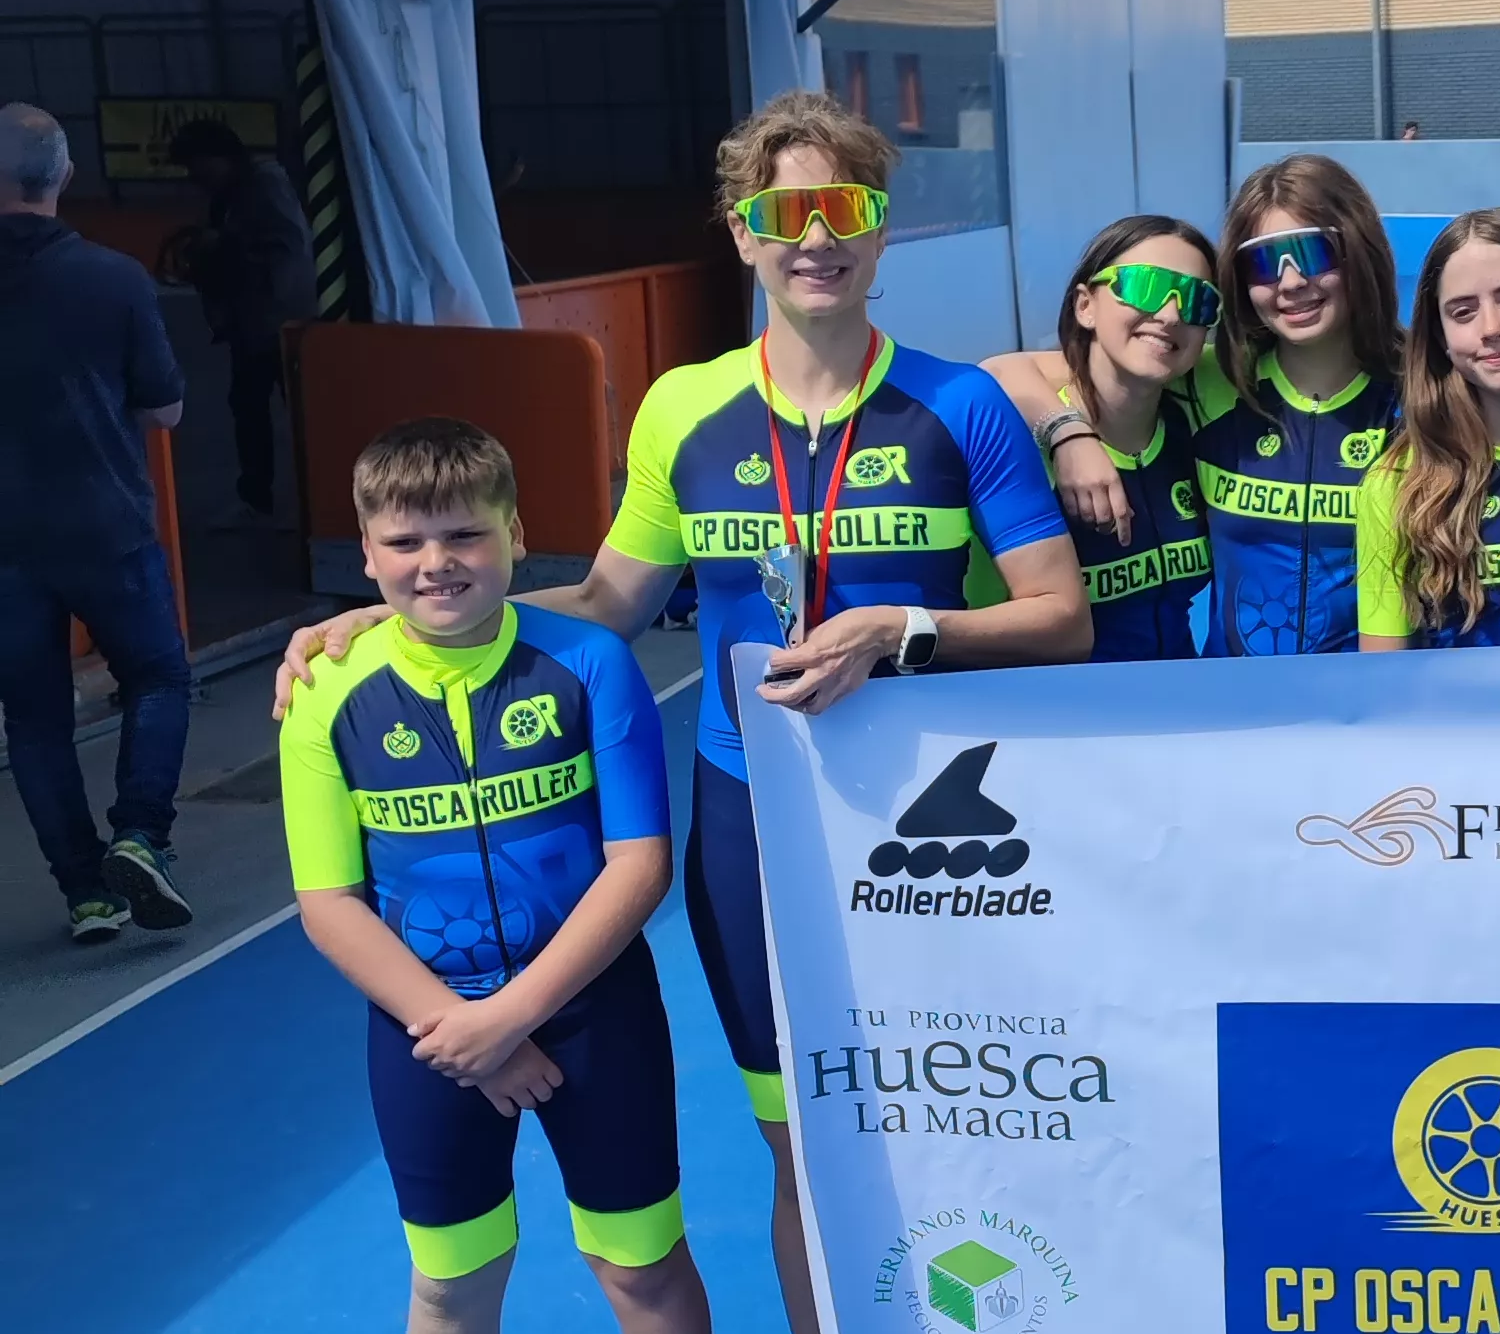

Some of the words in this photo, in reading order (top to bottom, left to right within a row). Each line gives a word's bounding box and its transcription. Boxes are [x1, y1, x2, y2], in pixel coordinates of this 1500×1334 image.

[1213, 474, 1238, 504] CP
[1237, 481, 1300, 517] OSCA
[1312, 489, 1358, 518] ROL
[692, 518, 717, 552] CP
[1096, 550, 1160, 598] OSCA
[367, 795, 390, 826] CP
[392, 790, 468, 827] OSCA
[480, 762, 578, 818] ROLLER
[851, 879, 1051, 918] Rollerblade
[874, 1207, 966, 1304] HERMANOS
[979, 1209, 1080, 1305] MARQUINA
[1265, 1267, 1336, 1332] CP
